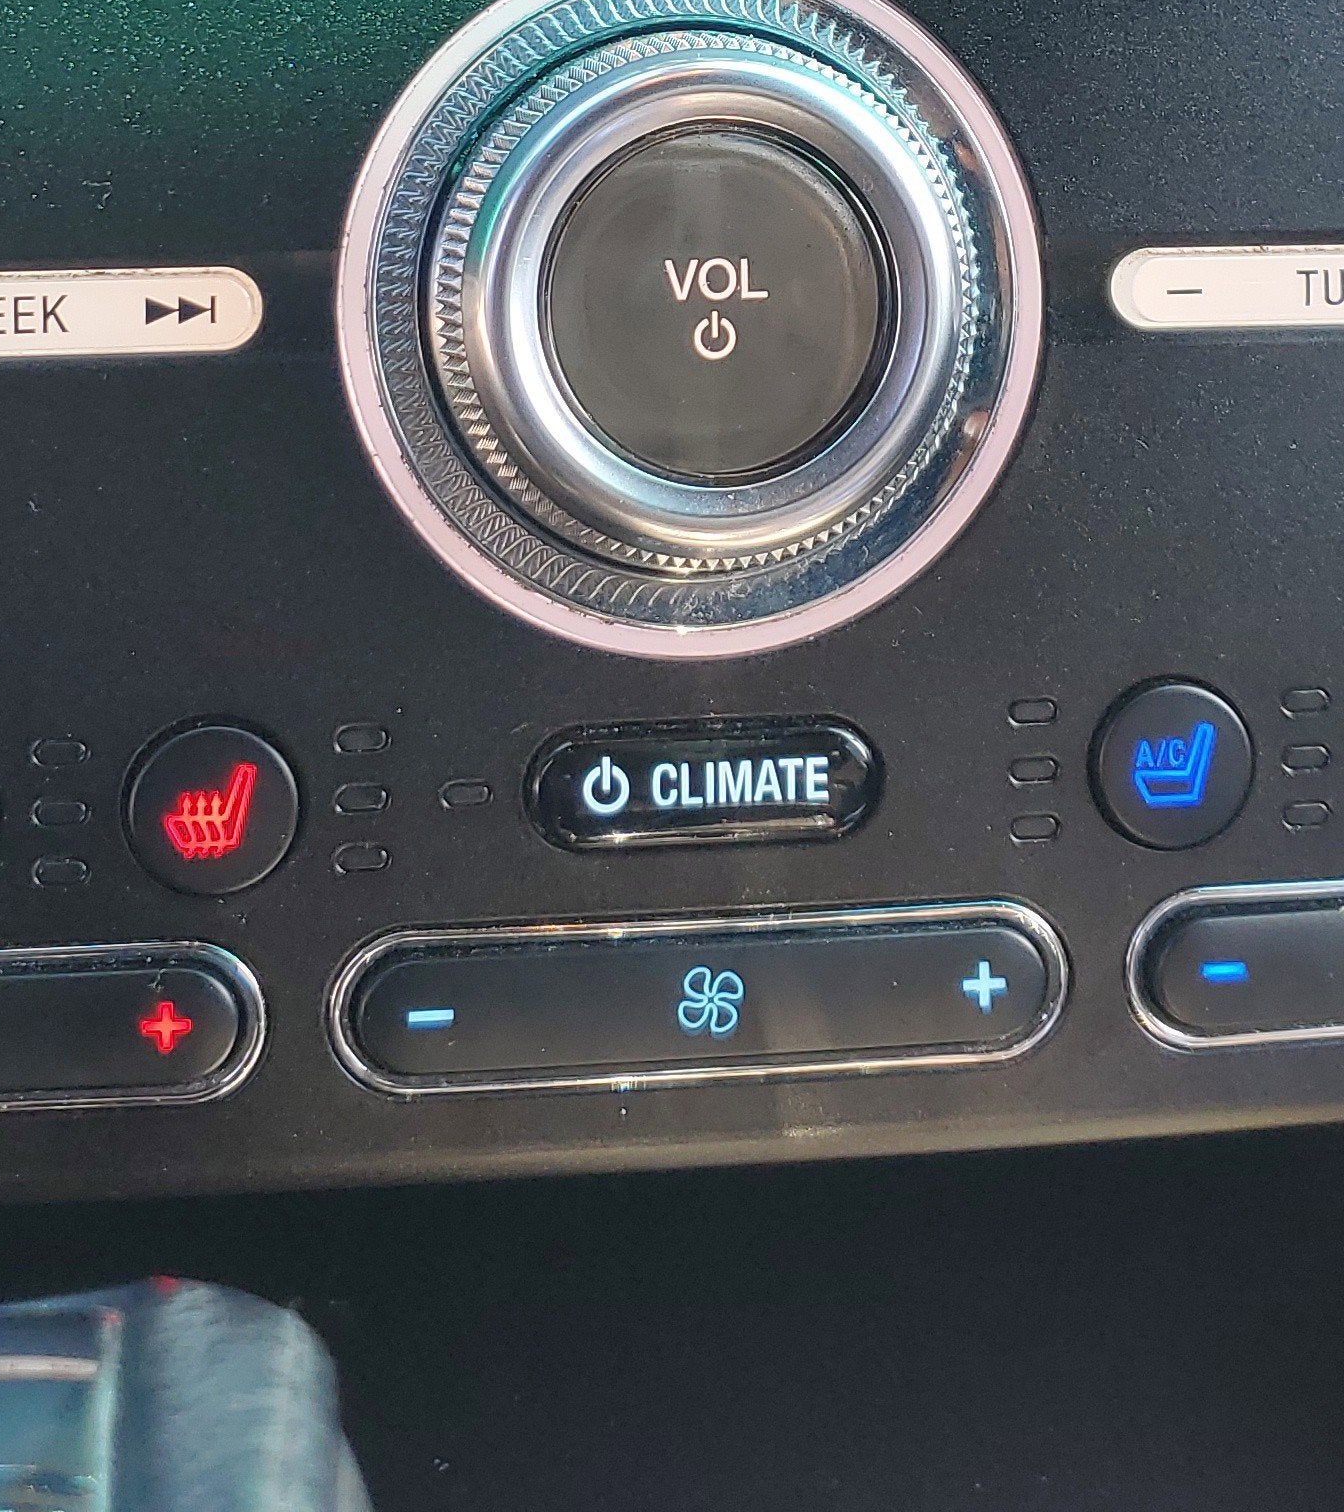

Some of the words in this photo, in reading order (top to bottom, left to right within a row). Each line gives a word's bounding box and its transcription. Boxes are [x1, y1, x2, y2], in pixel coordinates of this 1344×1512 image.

[664, 258, 768, 302] VOL
[1136, 738, 1186, 769] A/C
[654, 756, 830, 804] CLIMATE
